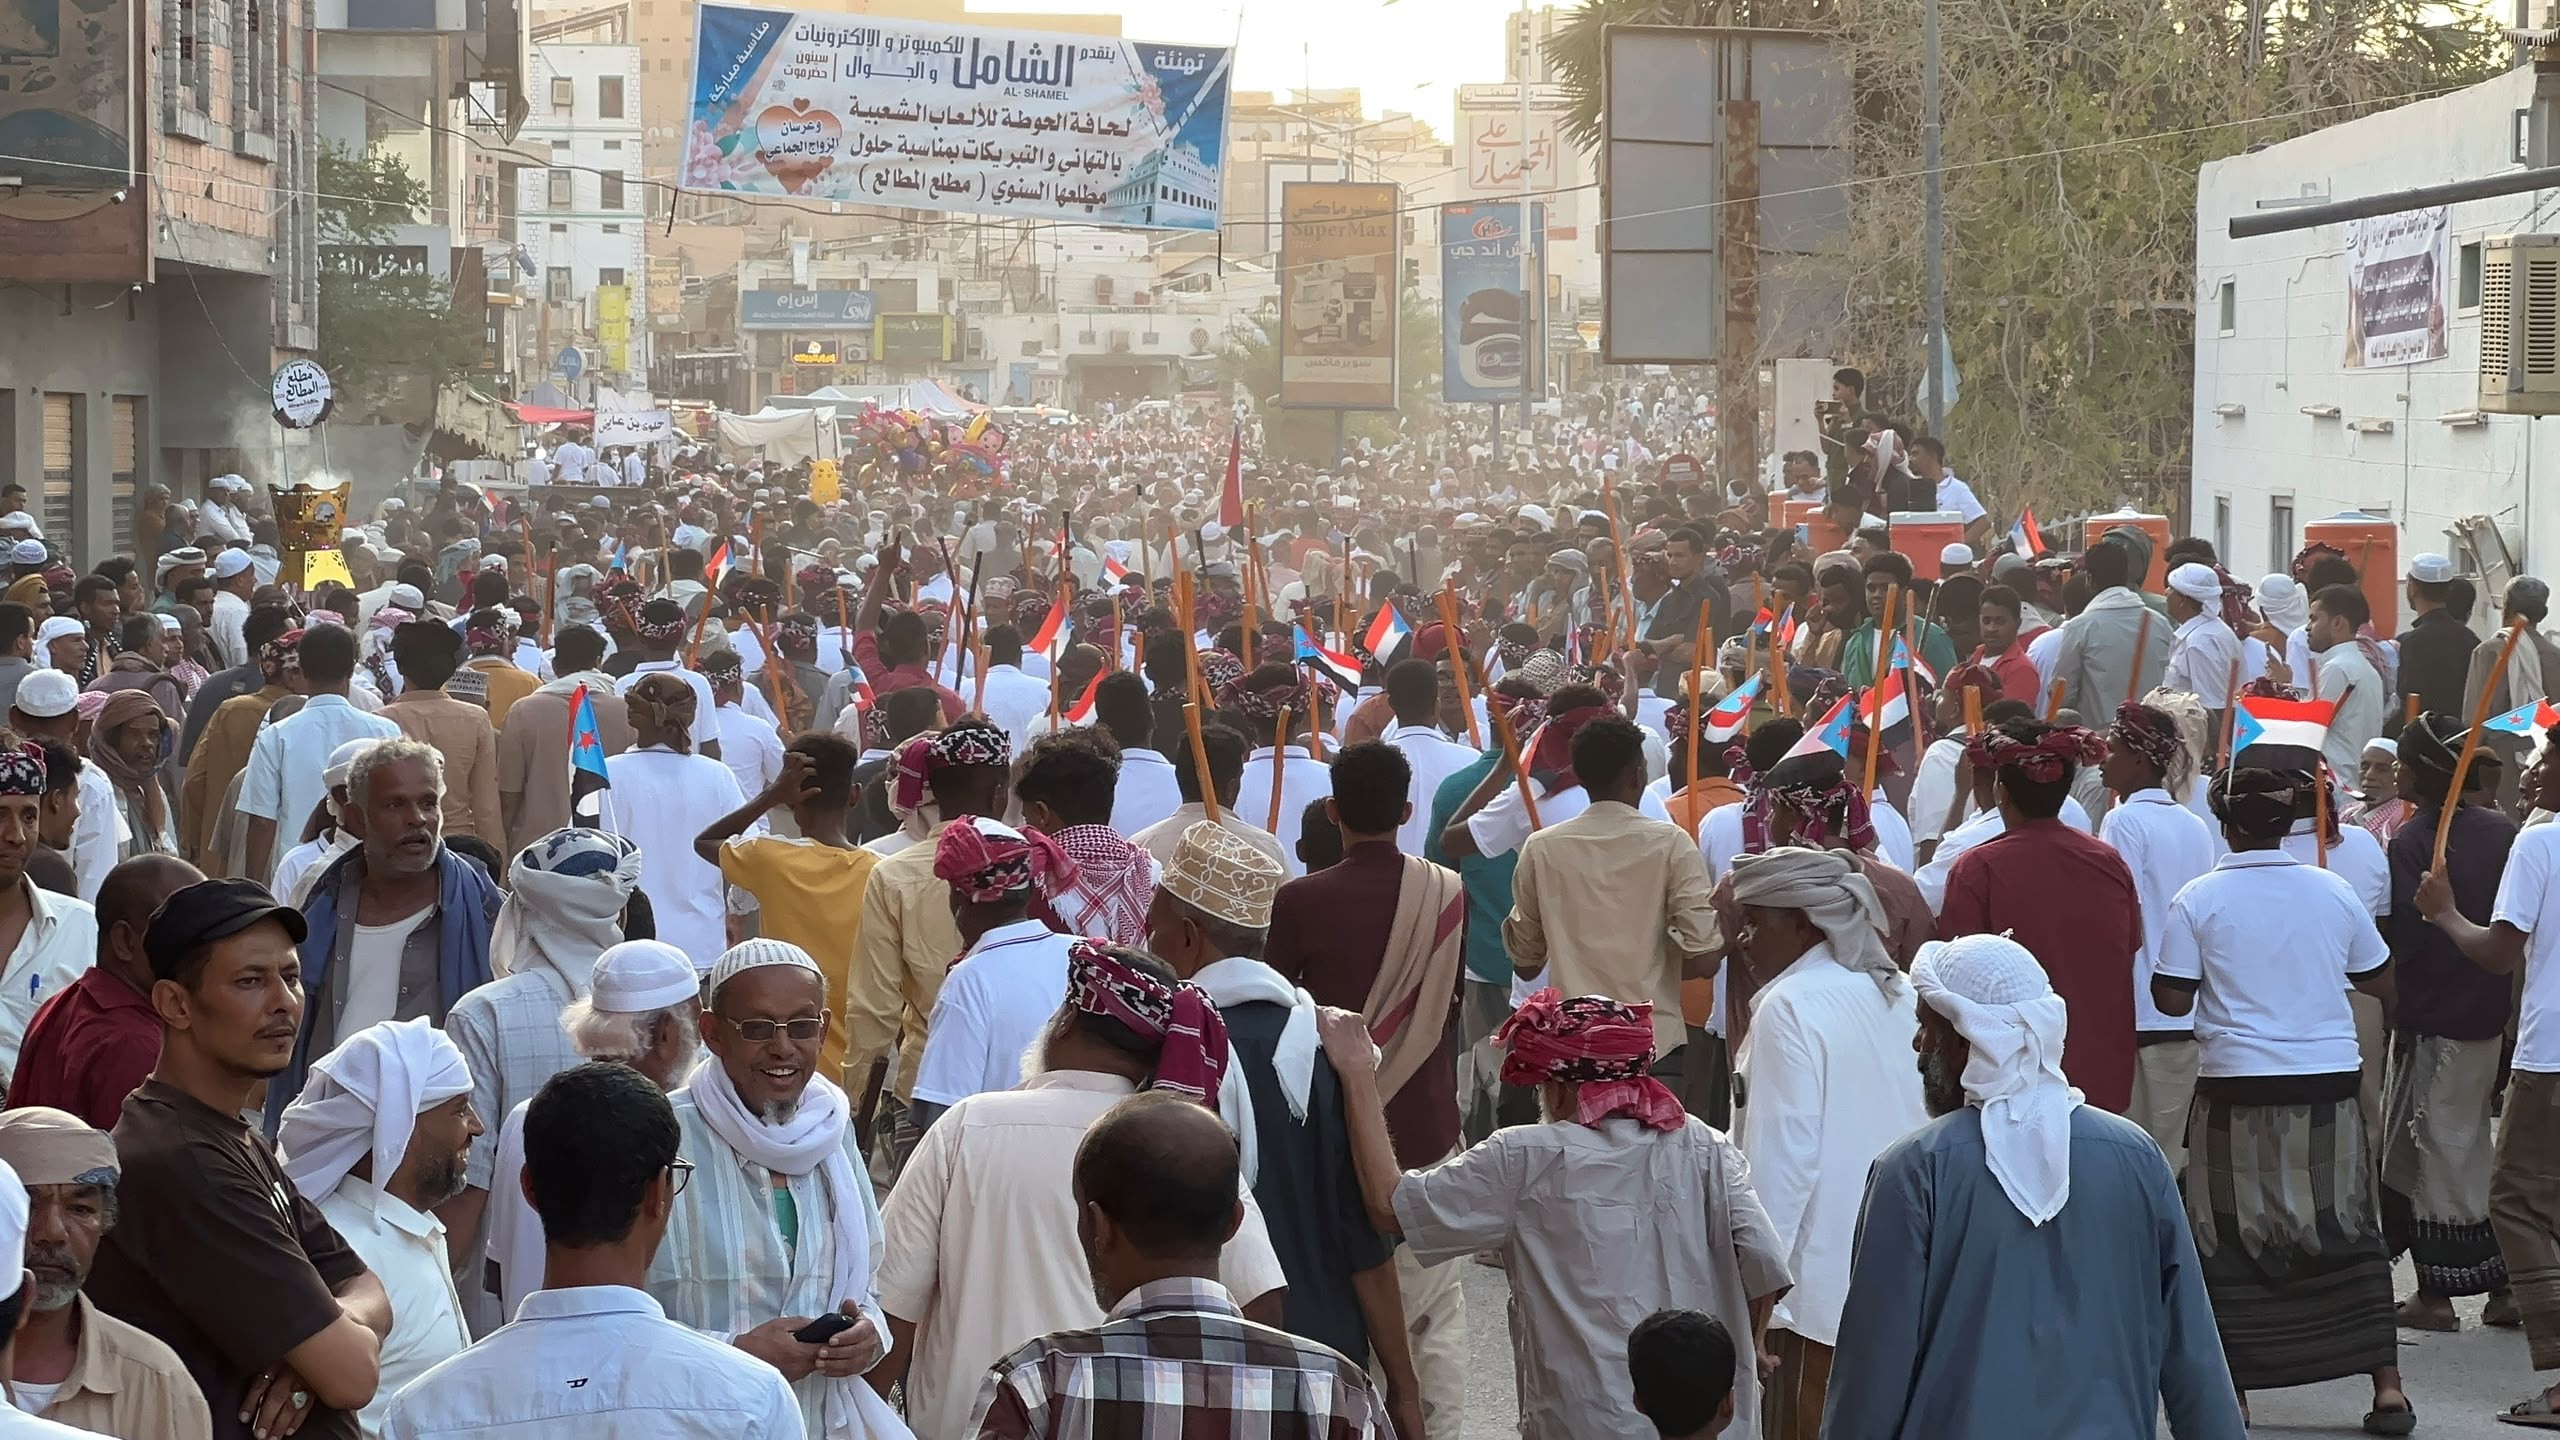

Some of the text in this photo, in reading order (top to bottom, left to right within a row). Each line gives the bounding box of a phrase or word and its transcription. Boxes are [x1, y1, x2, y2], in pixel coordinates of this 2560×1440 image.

[795, 23, 880, 51] الإلكترونيات
[898, 36, 964, 56] للكمبيوتر
[708, 20, 770, 103] مناسبة مباركة
[953, 37, 1076, 89] الشامل
[1079, 46, 1116, 64] يتقدم
[1154, 50, 1206, 75] تهنئة
[783, 65, 828, 79] حضرموت
[846, 56, 925, 82] الجوال
[1024, 88, 1069, 101] SHAMEL
[849, 95, 1132, 137] لحافة الحوطة للألعاب الشعبية
[850, 132, 1122, 177] بالتهاني والتبريكات بمناسبة حلول
[873, 165, 926, 195] المطالع
[929, 172, 971, 200] مطلع
[991, 177, 1049, 207] السنوي
[286, 380, 319, 402] المطالع
[287, 369, 313, 388] مطلع
[627, 417, 639, 432] بن
